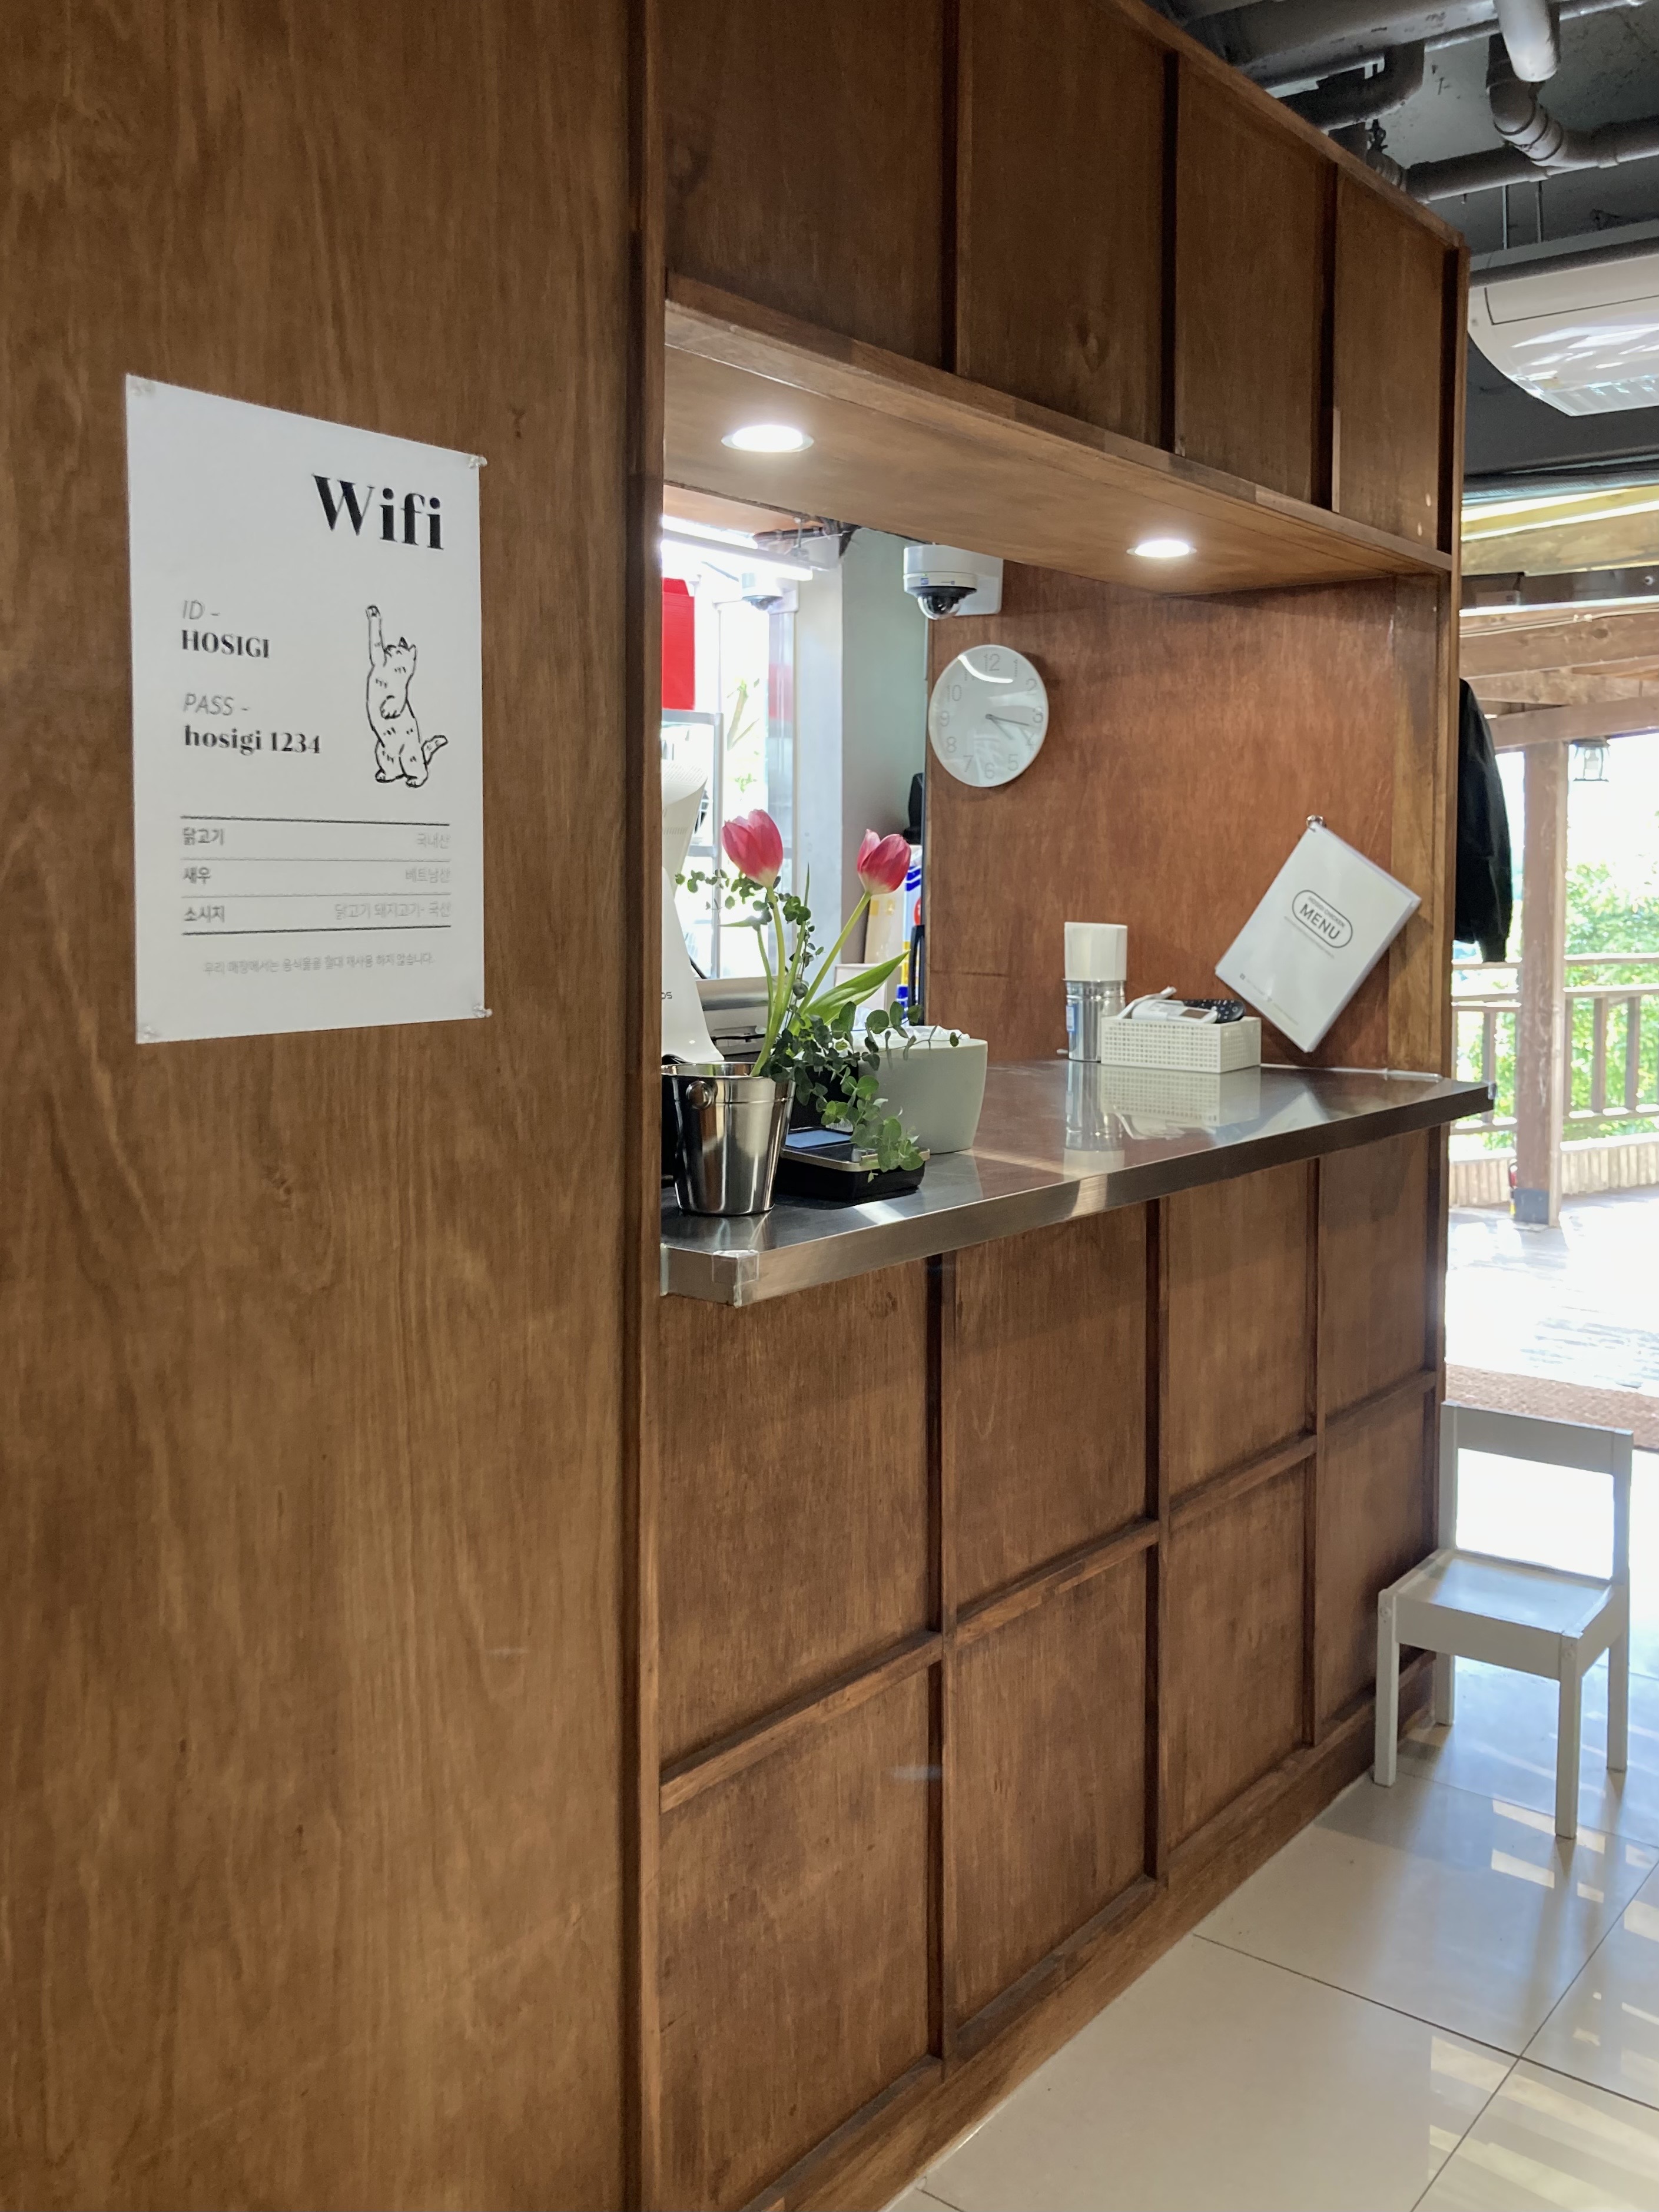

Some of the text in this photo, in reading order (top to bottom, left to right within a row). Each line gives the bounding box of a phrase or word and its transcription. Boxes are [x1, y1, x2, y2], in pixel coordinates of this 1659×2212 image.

[311, 473, 444, 550] Wifi
[183, 599, 205, 619] ID
[181, 629, 270, 659] HOSIGI
[983, 654, 1001, 672] 12
[946, 684, 963, 702] 10
[183, 693, 234, 716] PASS
[940, 710, 950, 727] 9
[184, 725, 321, 756] hosigi 1234
[945, 736, 957, 754] 8
[963, 754, 974, 773] 7
[984, 761, 995, 780] 6
[1007, 753, 1020, 772] 5
[183, 827, 225, 846] 닭고기
[416, 832, 450, 849] 국내산
[183, 867, 211, 884] 새우
[405, 867, 451, 883] 베트남산
[184, 906, 225, 923] 소시지
[334, 903, 371, 920] 닭고기
[1299, 903, 1341, 940] MENU
